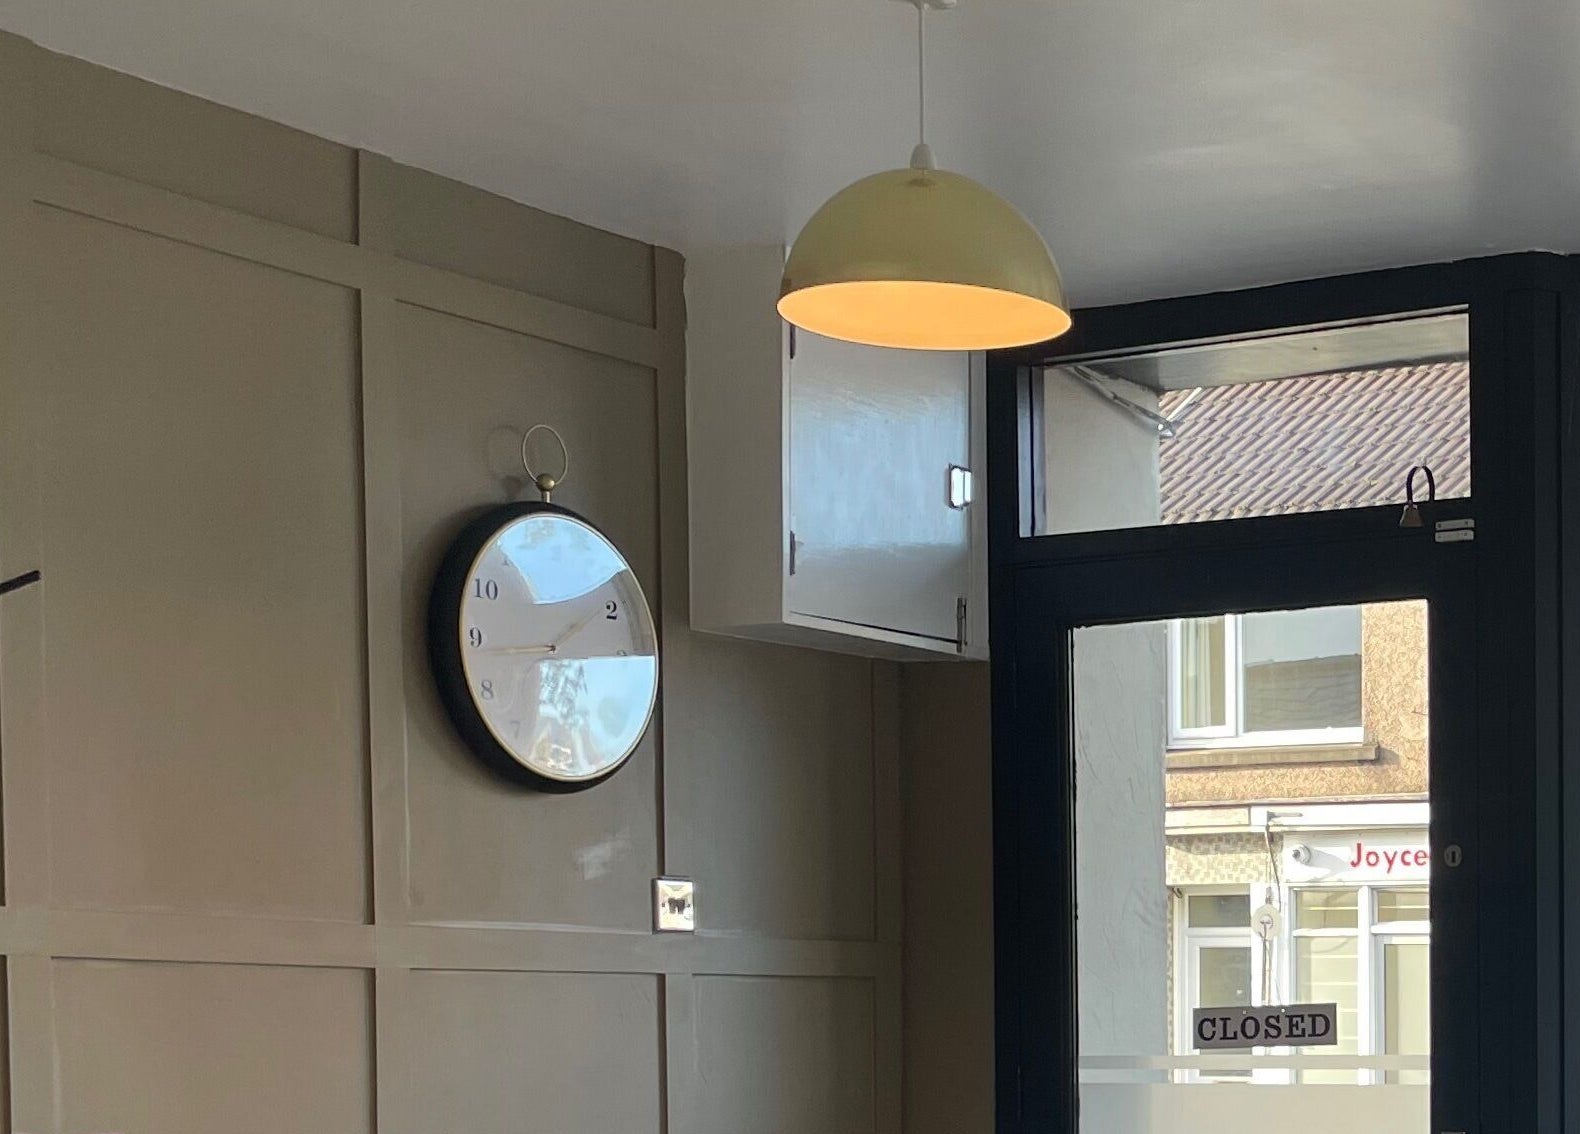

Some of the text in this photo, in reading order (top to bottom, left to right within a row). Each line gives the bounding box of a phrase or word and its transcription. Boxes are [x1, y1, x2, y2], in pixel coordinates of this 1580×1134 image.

[474, 578, 498, 600] 10
[605, 600, 618, 621] 2
[469, 627, 483, 648] 9
[480, 678, 494, 700] 8
[1350, 842, 1430, 874] Joyce
[1197, 1013, 1331, 1042] CLOSED
